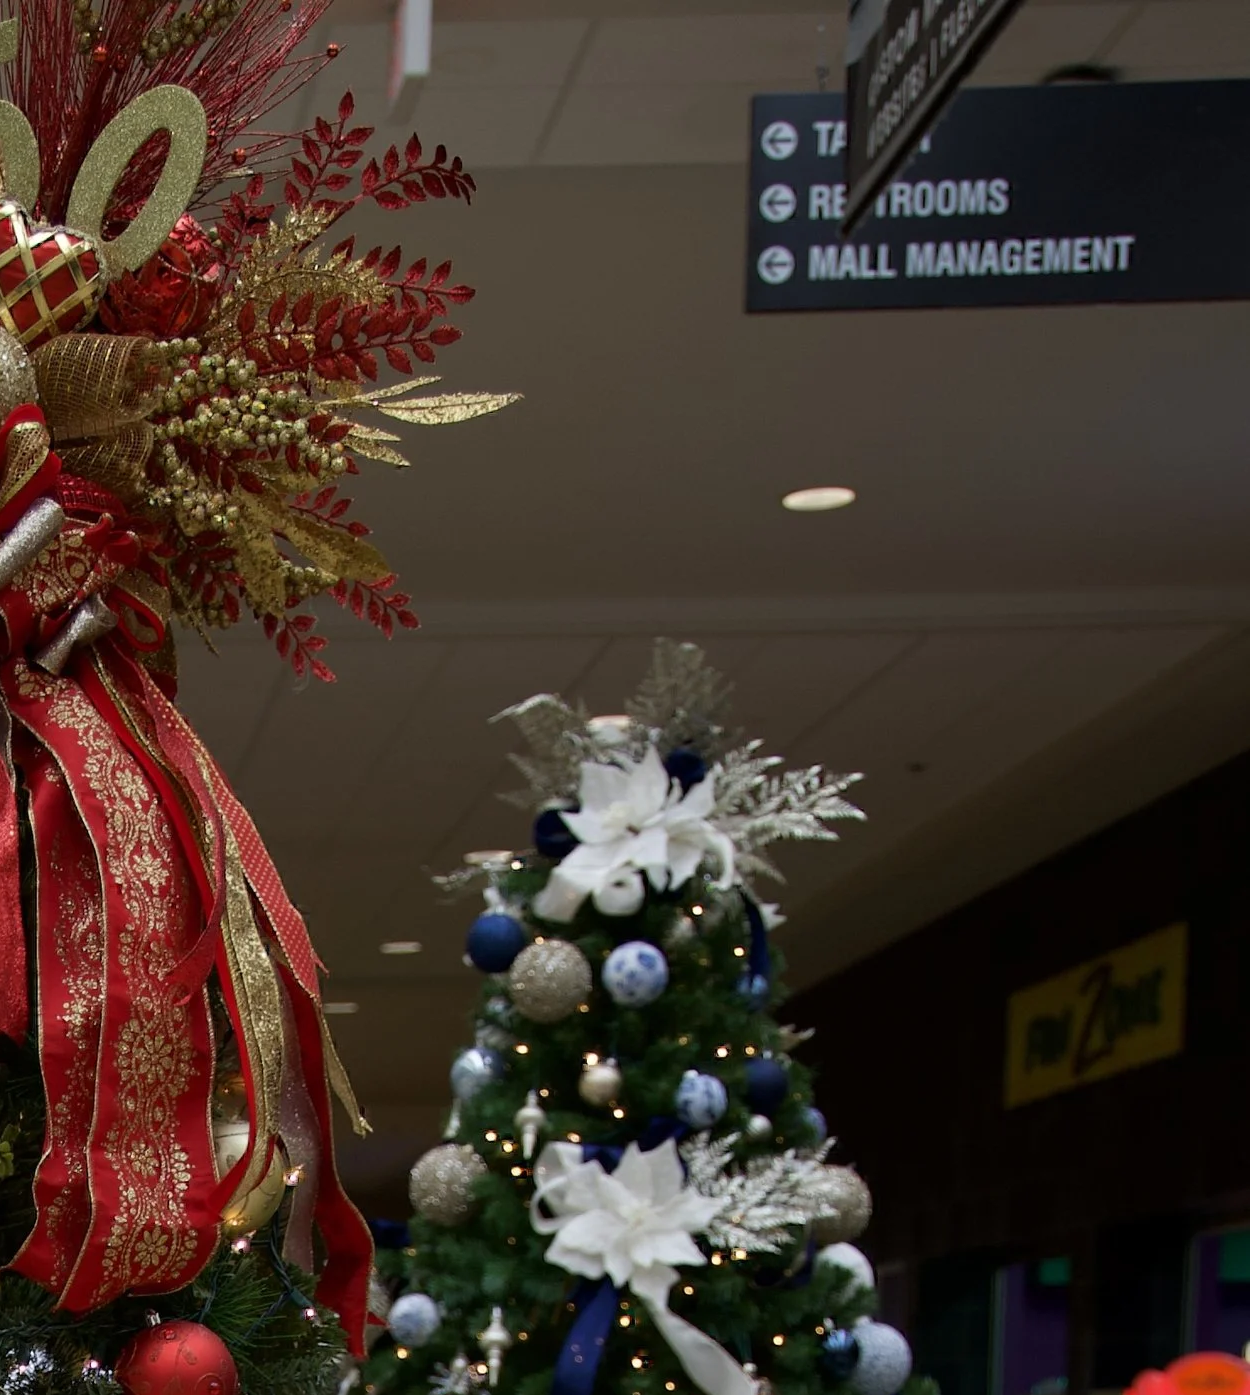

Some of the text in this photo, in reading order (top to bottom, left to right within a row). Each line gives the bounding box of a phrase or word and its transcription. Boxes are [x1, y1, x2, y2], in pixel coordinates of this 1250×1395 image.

[809, 178, 1010, 220] RETROOMS
[808, 236, 1135, 281] MALL MANAGEMENT
